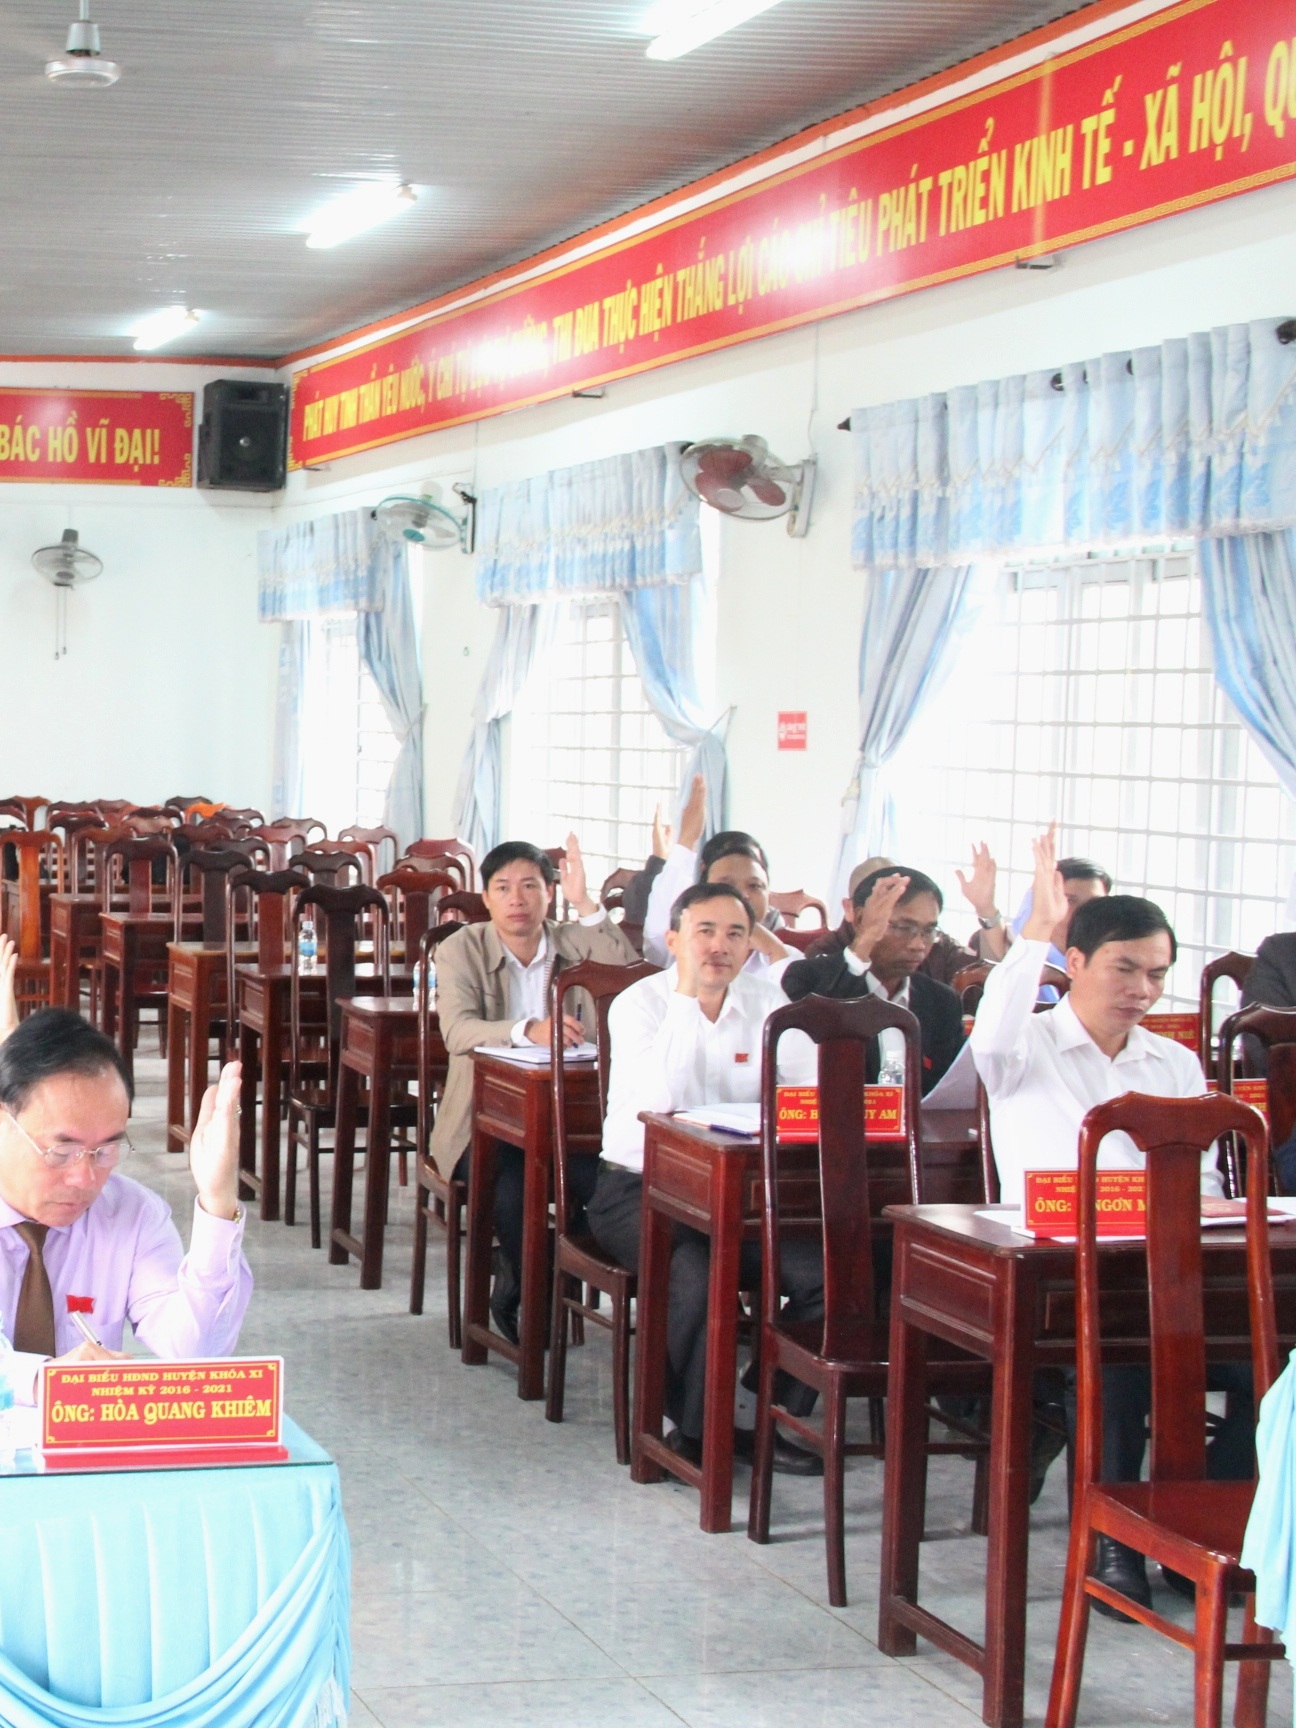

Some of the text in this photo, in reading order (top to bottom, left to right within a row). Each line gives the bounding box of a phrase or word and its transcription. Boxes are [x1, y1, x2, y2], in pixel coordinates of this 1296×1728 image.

[382, 363, 400, 417] YÊU
[553, 311, 573, 364] THI
[574, 301, 600, 356] ĐUA
[603, 279, 638, 354] THỰC
[639, 264, 673, 341] HIỆN
[676, 236, 725, 323] THẮNG
[727, 236, 754, 314] LỢI
[829, 189, 872, 274] TIÊU
[877, 164, 932, 257] PHÁT
[938, 117, 1007, 237] TRIỂN
[1011, 125, 1073, 214] KINH
[1081, 76, 1122, 190] TẾ
[1140, 61, 1182, 171] XÃ
[1189, 41, 1253, 162] HỘI,
[48, 410, 78, 464] HỒ
[86, 418, 111, 464] VĨ
[114, 428, 160, 472] ĐẠI!
[779, 1107, 807, 1120] ÔNG:
[879, 1109, 897, 1120] AM
[1035, 1197, 1071, 1212] ÔNG:
[61, 1369, 263, 1384] ĐẠI BIỂU HĐND HUYỆN KHÓA XI
[91, 1385, 135, 1397] NHIỆM
[138, 1384, 156, 1395] KỲ
[160, 1385, 191, 1394] 2016
[202, 1384, 232, 1393] 2021
[51, 1395, 272, 1425] ÔNG: HÒA QUANG KHIÊM
